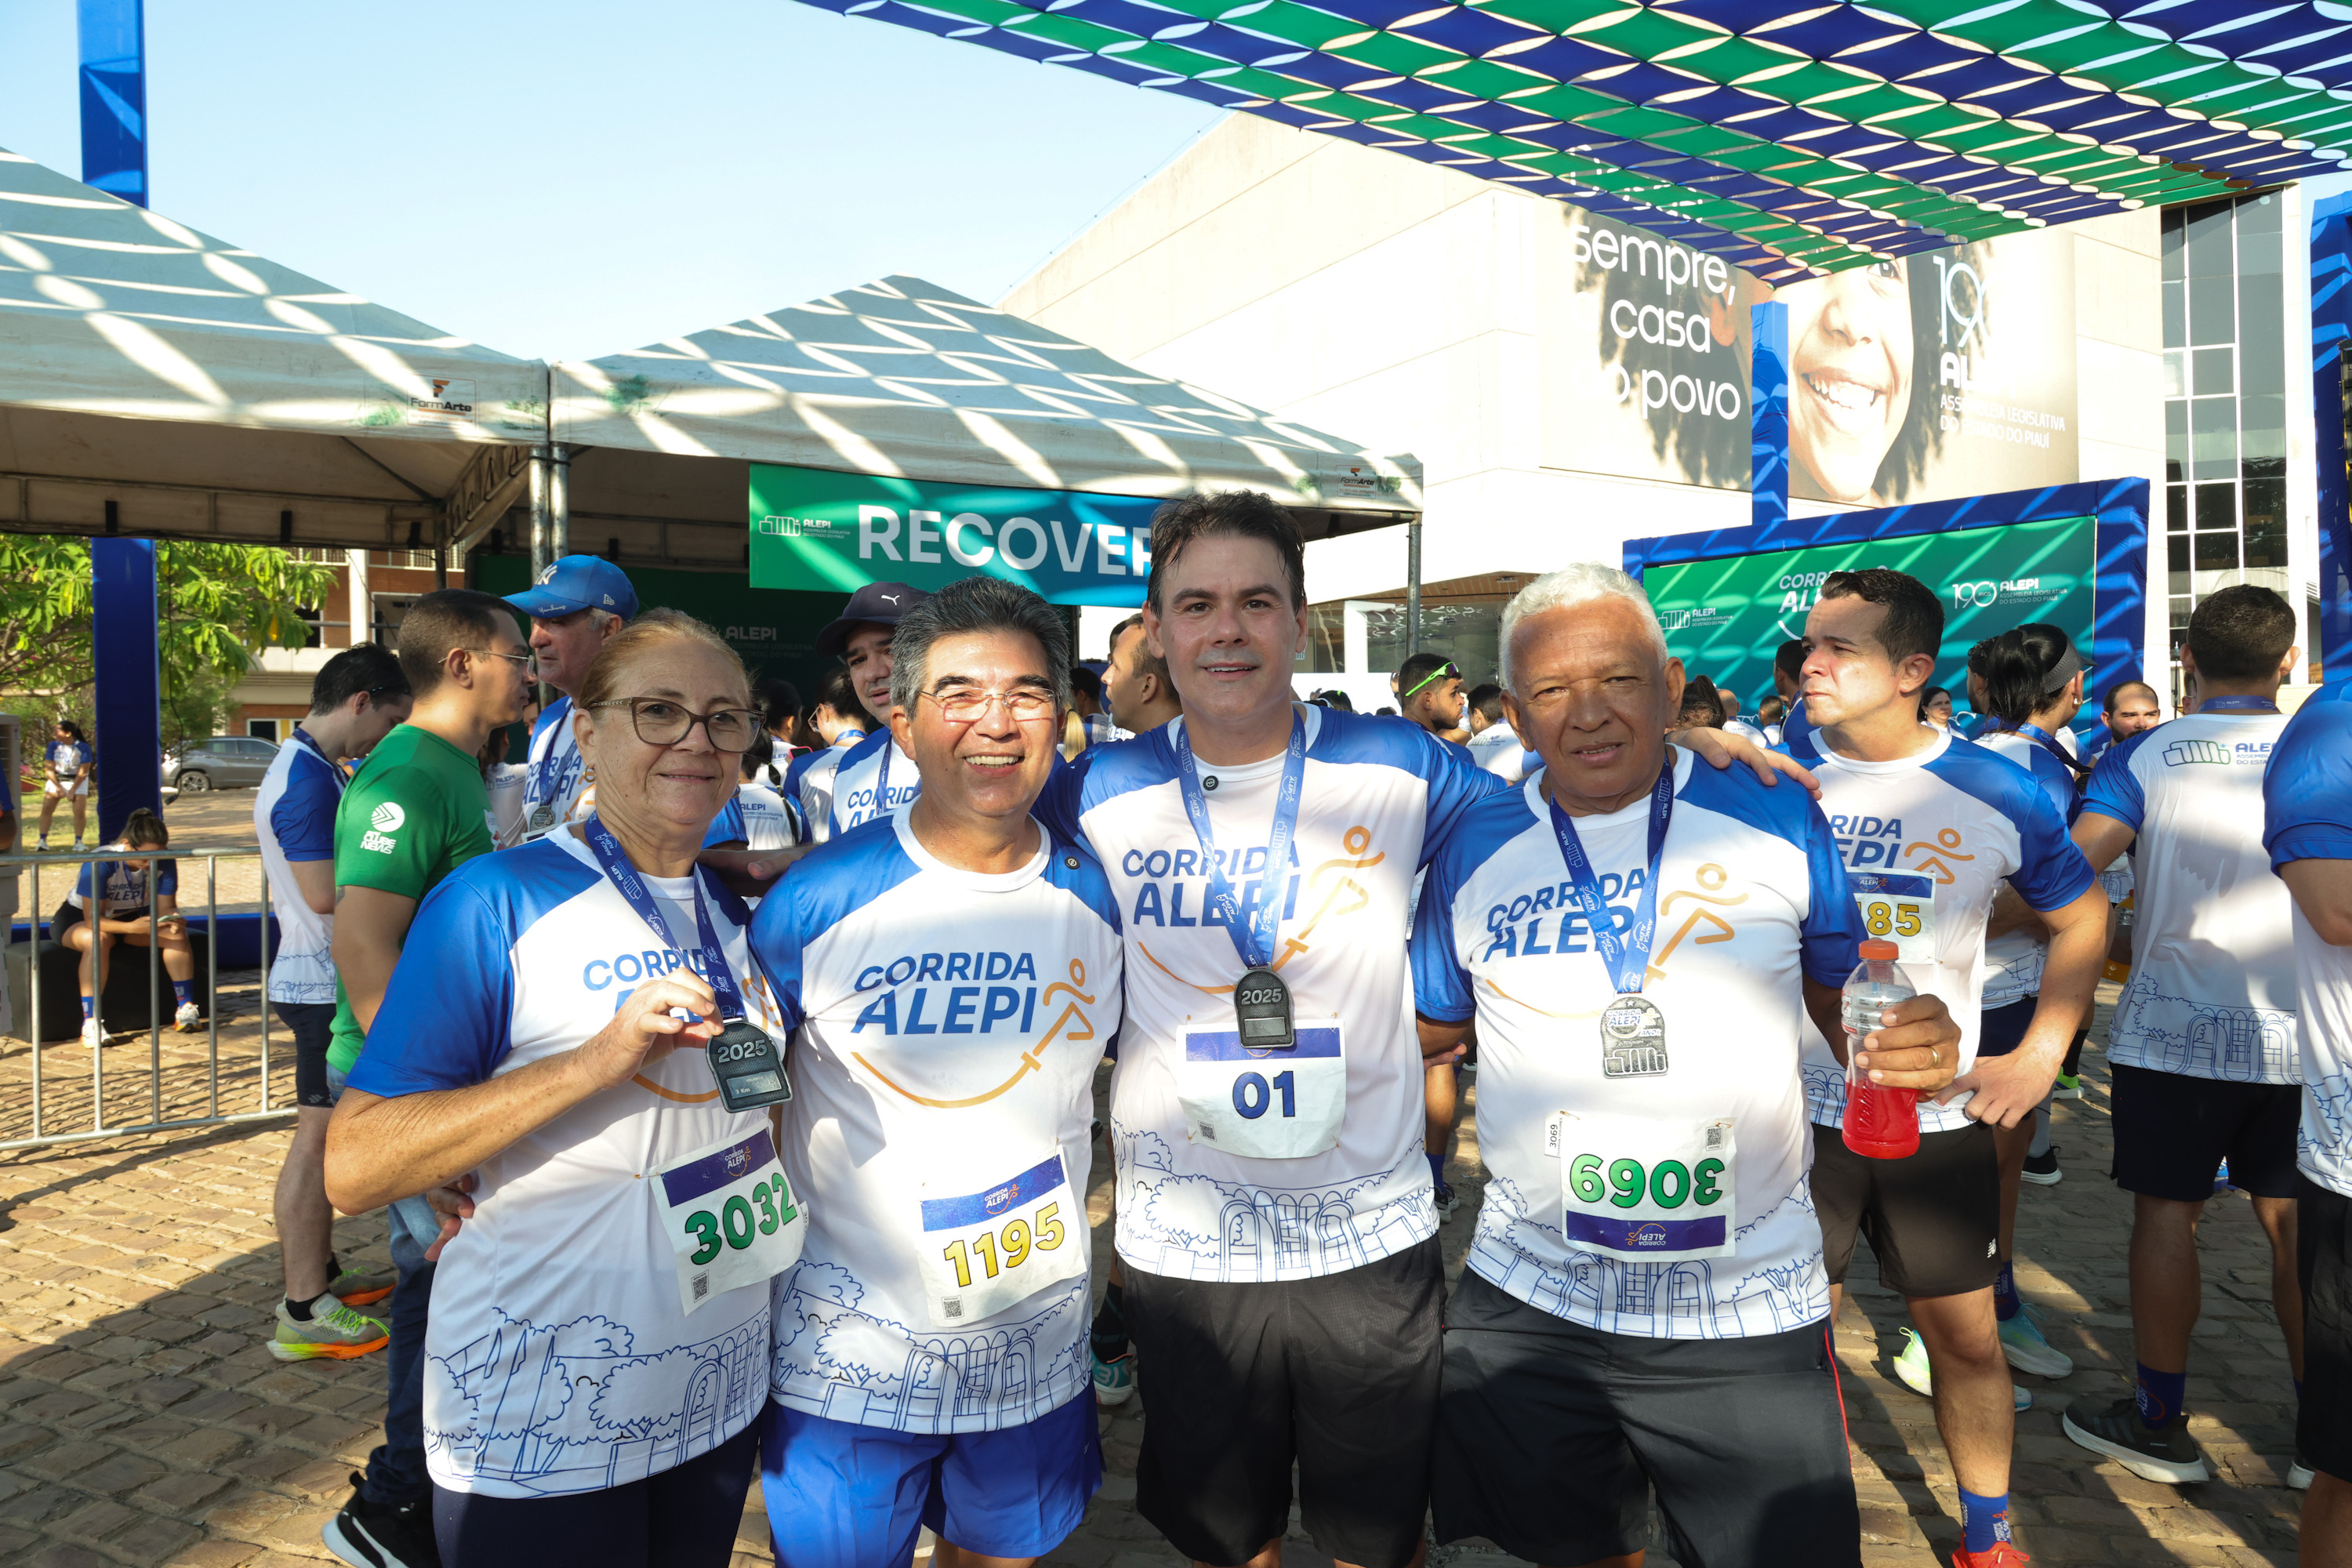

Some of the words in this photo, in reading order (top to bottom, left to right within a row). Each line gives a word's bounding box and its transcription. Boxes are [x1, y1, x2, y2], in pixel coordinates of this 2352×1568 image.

[1570, 223, 1736, 306] sempre,
[1610, 299, 1711, 354] casa
[410, 397, 472, 412] FormArte
[1642, 368, 1741, 420] povo
[1940, 415, 1959, 432] DO
[1962, 419, 2004, 440] ESTADO
[2006, 426, 2023, 443] DO
[2008, 407, 2065, 432] LEGISLATIVA
[1340, 477, 1375, 485] FormArte
[803, 518, 831, 529] ALEPI
[1779, 568, 1855, 590] CORR
[2000, 578, 2038, 591] ALEPI
[1952, 581, 1997, 609] 190
[1692, 608, 1716, 618] ALEPI
[725, 626, 776, 641] ALEPI
[524, 774, 579, 805] ALPI
[1560, 829, 1570, 846] ALEPI
[1830, 815, 1902, 840] RIDA
[605, 837, 614, 849] ALEPI
[610, 865, 624, 881] ALEPI
[1225, 899, 1236, 915] ALEPI
[1486, 868, 1646, 933] CORRDA
[1582, 895, 1592, 913] CORRIDA
[1587, 893, 1596, 911] ALEPI
[1221, 903, 1236, 924] AVANÇA
[1857, 902, 1922, 937] 85
[1483, 906, 1635, 963] ALEP
[1644, 918, 1653, 942] AVANÇA
[1601, 939, 1613, 962] AVANÇA
[1606, 938, 1615, 954] ALEPI
[855, 952, 1036, 993] CORRIDA
[1241, 988, 1283, 1005] 2025
[850, 986, 1037, 1035] ALEPI
[1609, 1015, 1641, 1025] ALEPI
[717, 1039, 768, 1063] 2025
[1232, 1070, 1296, 1120] 01
[1549, 1124, 1559, 1148] 3069
[724, 1149, 744, 1161] CORRIDA
[728, 1155, 746, 1169] ALEPI
[1570, 1153, 1725, 1209] 3069
[985, 1188, 1008, 1202] CORRIDA
[985, 1192, 1009, 1209] ALEPI
[684, 1172, 798, 1265] 3032
[943, 1201, 1065, 1287] 1195
